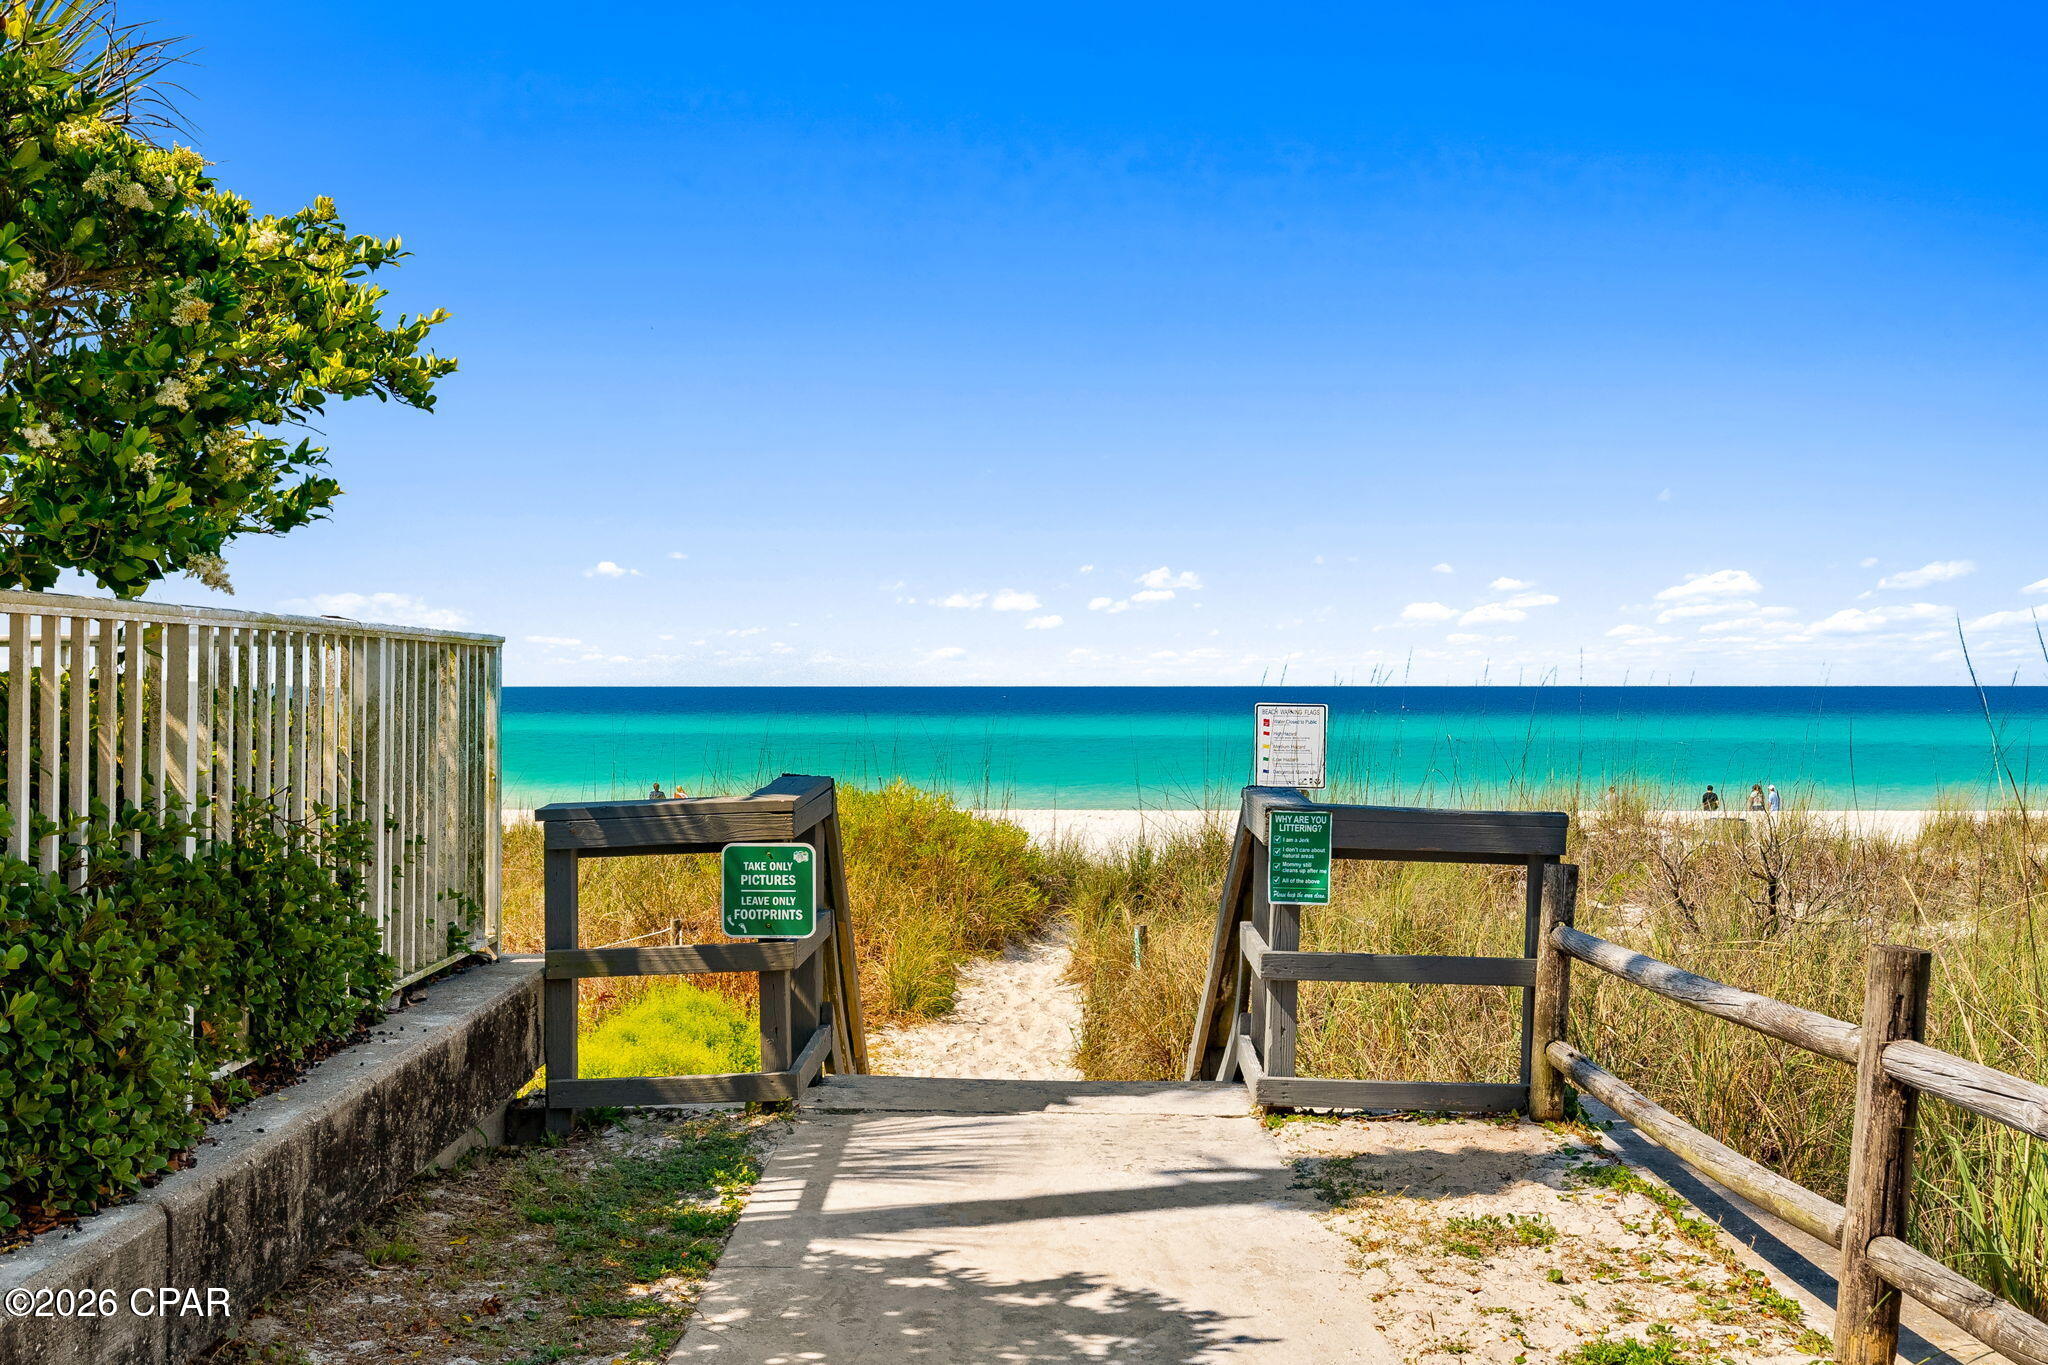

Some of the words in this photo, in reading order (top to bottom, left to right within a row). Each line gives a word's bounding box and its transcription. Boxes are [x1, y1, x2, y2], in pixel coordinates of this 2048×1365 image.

[1279, 824, 1322, 832] LITTERING?
[743, 862, 766, 870] TAKE
[770, 862, 793, 870] ONLY
[741, 875, 796, 885] PICTURES
[741, 897, 769, 905] LEAVE
[772, 897, 796, 905] ONLY
[734, 909, 803, 920] FOOTPRINTS
